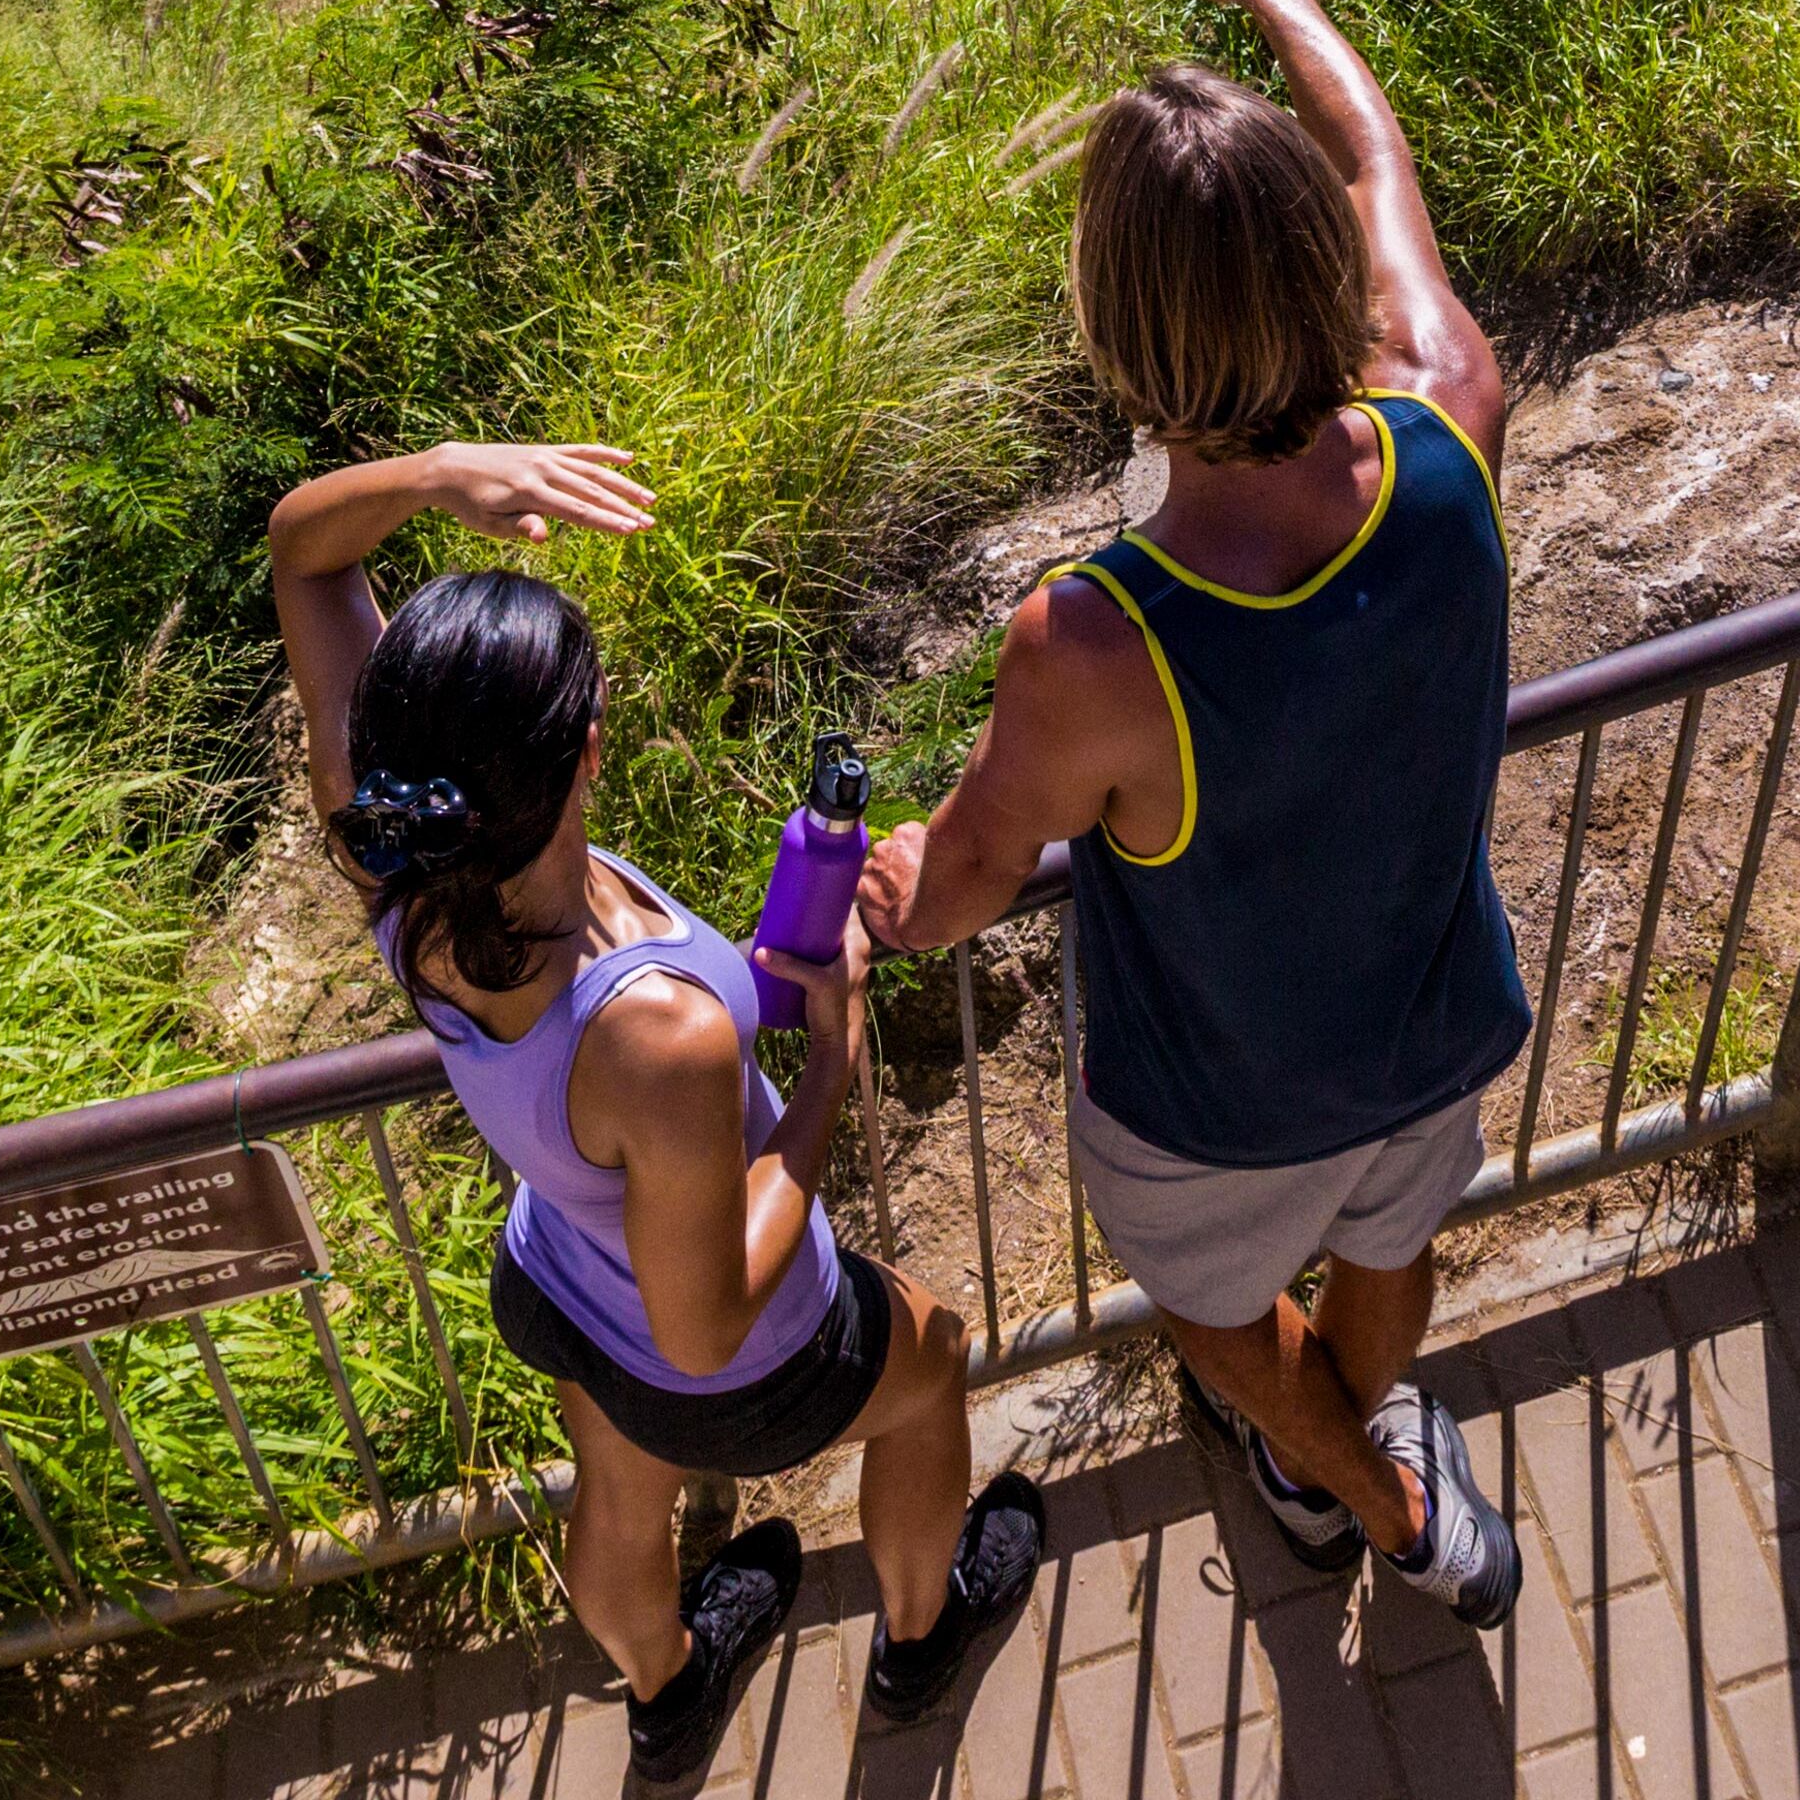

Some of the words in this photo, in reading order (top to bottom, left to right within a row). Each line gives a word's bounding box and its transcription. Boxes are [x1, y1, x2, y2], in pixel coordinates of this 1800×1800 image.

[45, 1206, 108, 1224] the
[116, 1171, 235, 1208] railing
[21, 1218, 131, 1254] safety
[141, 1196, 210, 1225] and
[76, 1223, 222, 1262] erosion.
[146, 1263, 240, 1298] Head
